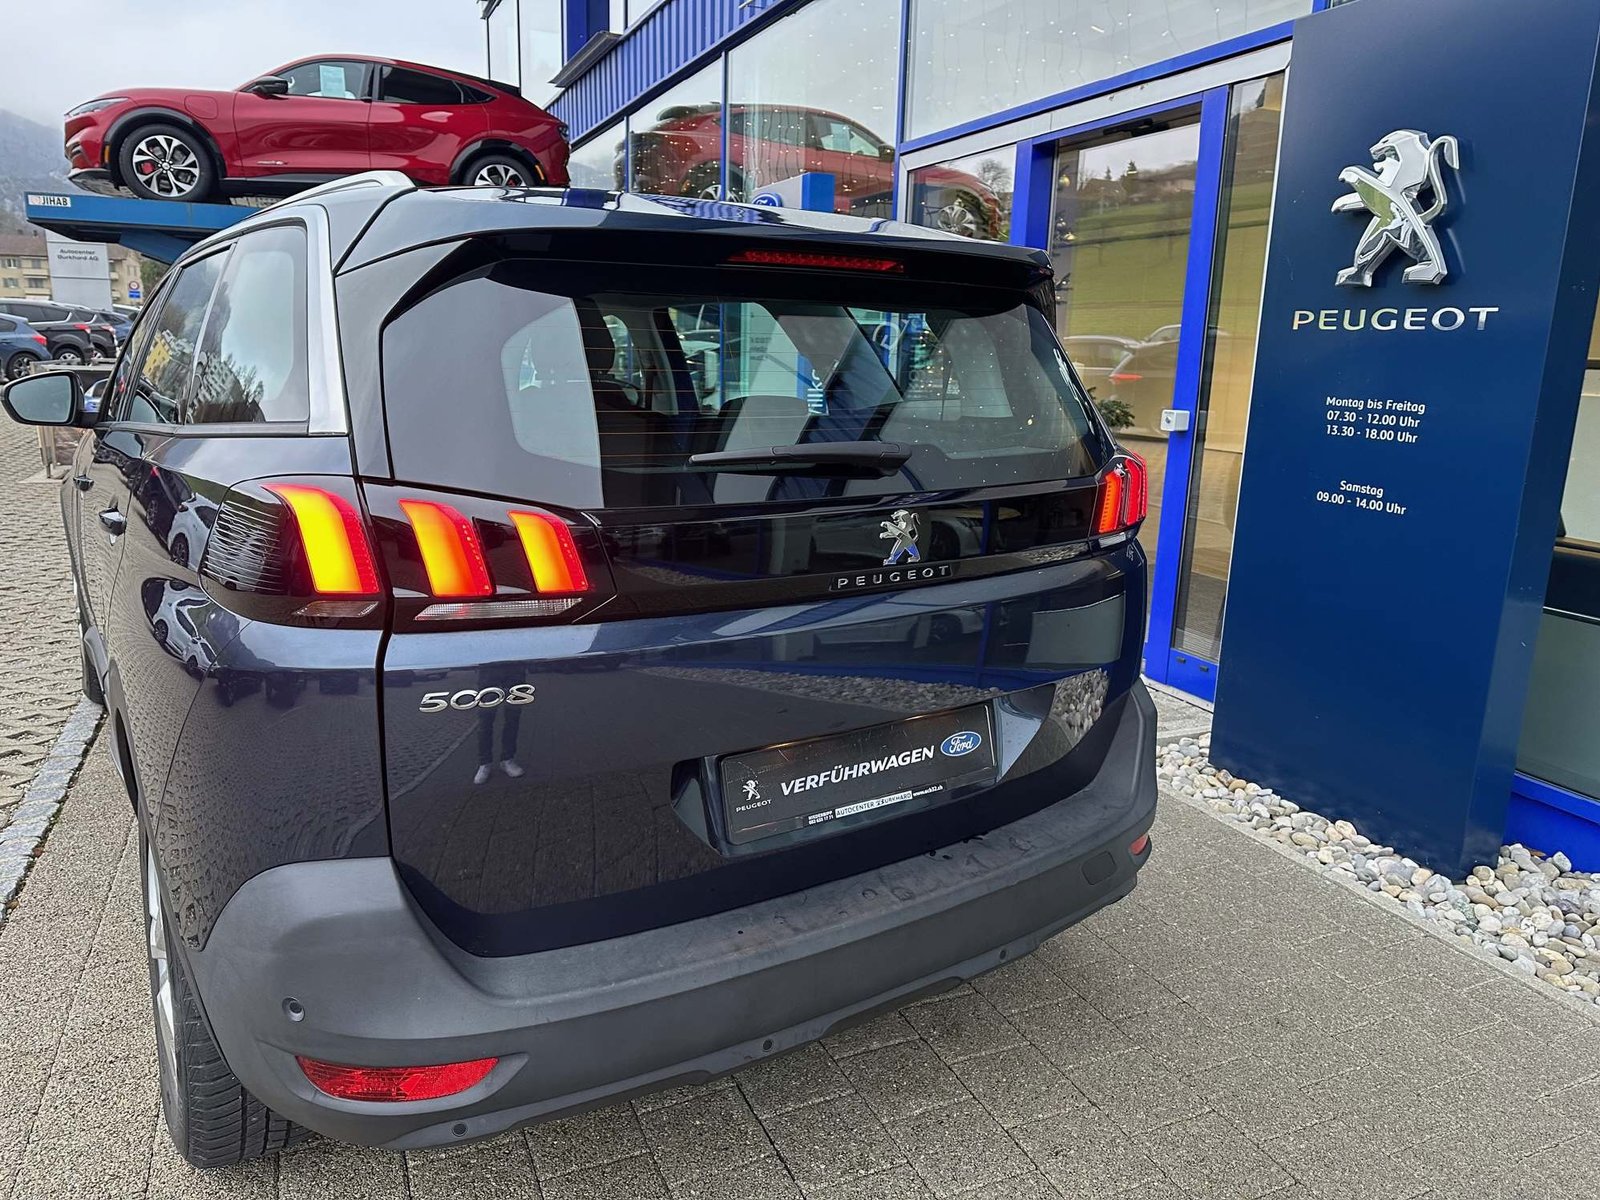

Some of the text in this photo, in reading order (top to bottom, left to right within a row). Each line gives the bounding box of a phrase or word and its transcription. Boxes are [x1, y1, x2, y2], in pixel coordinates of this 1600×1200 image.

[42, 196, 68, 206] JIHAB
[1292, 306, 1500, 331] PEUGEOT
[1326, 396, 1426, 415] Montag bis Freitag
[1326, 410, 1357, 422] 07.30
[1367, 413, 1397, 426] 12.00
[1399, 416, 1420, 428] Uhr
[1326, 424, 1355, 437] 13.30
[1365, 428, 1394, 441] 18.00
[1397, 431, 1418, 443] Uhr
[1340, 480, 1384, 498] Samstag
[1316, 490, 1345, 504] 09.00
[1356, 497, 1384, 511] 14.00
[1386, 502, 1407, 515] Uhr
[837, 565, 949, 589] PEUGEOT
[419, 683, 536, 713] 5008
[780, 745, 935, 796] VERFÜHRWAGEN
[735, 799, 772, 813] PEUGEOT
[836, 803, 875, 816] AUTOCENTER
